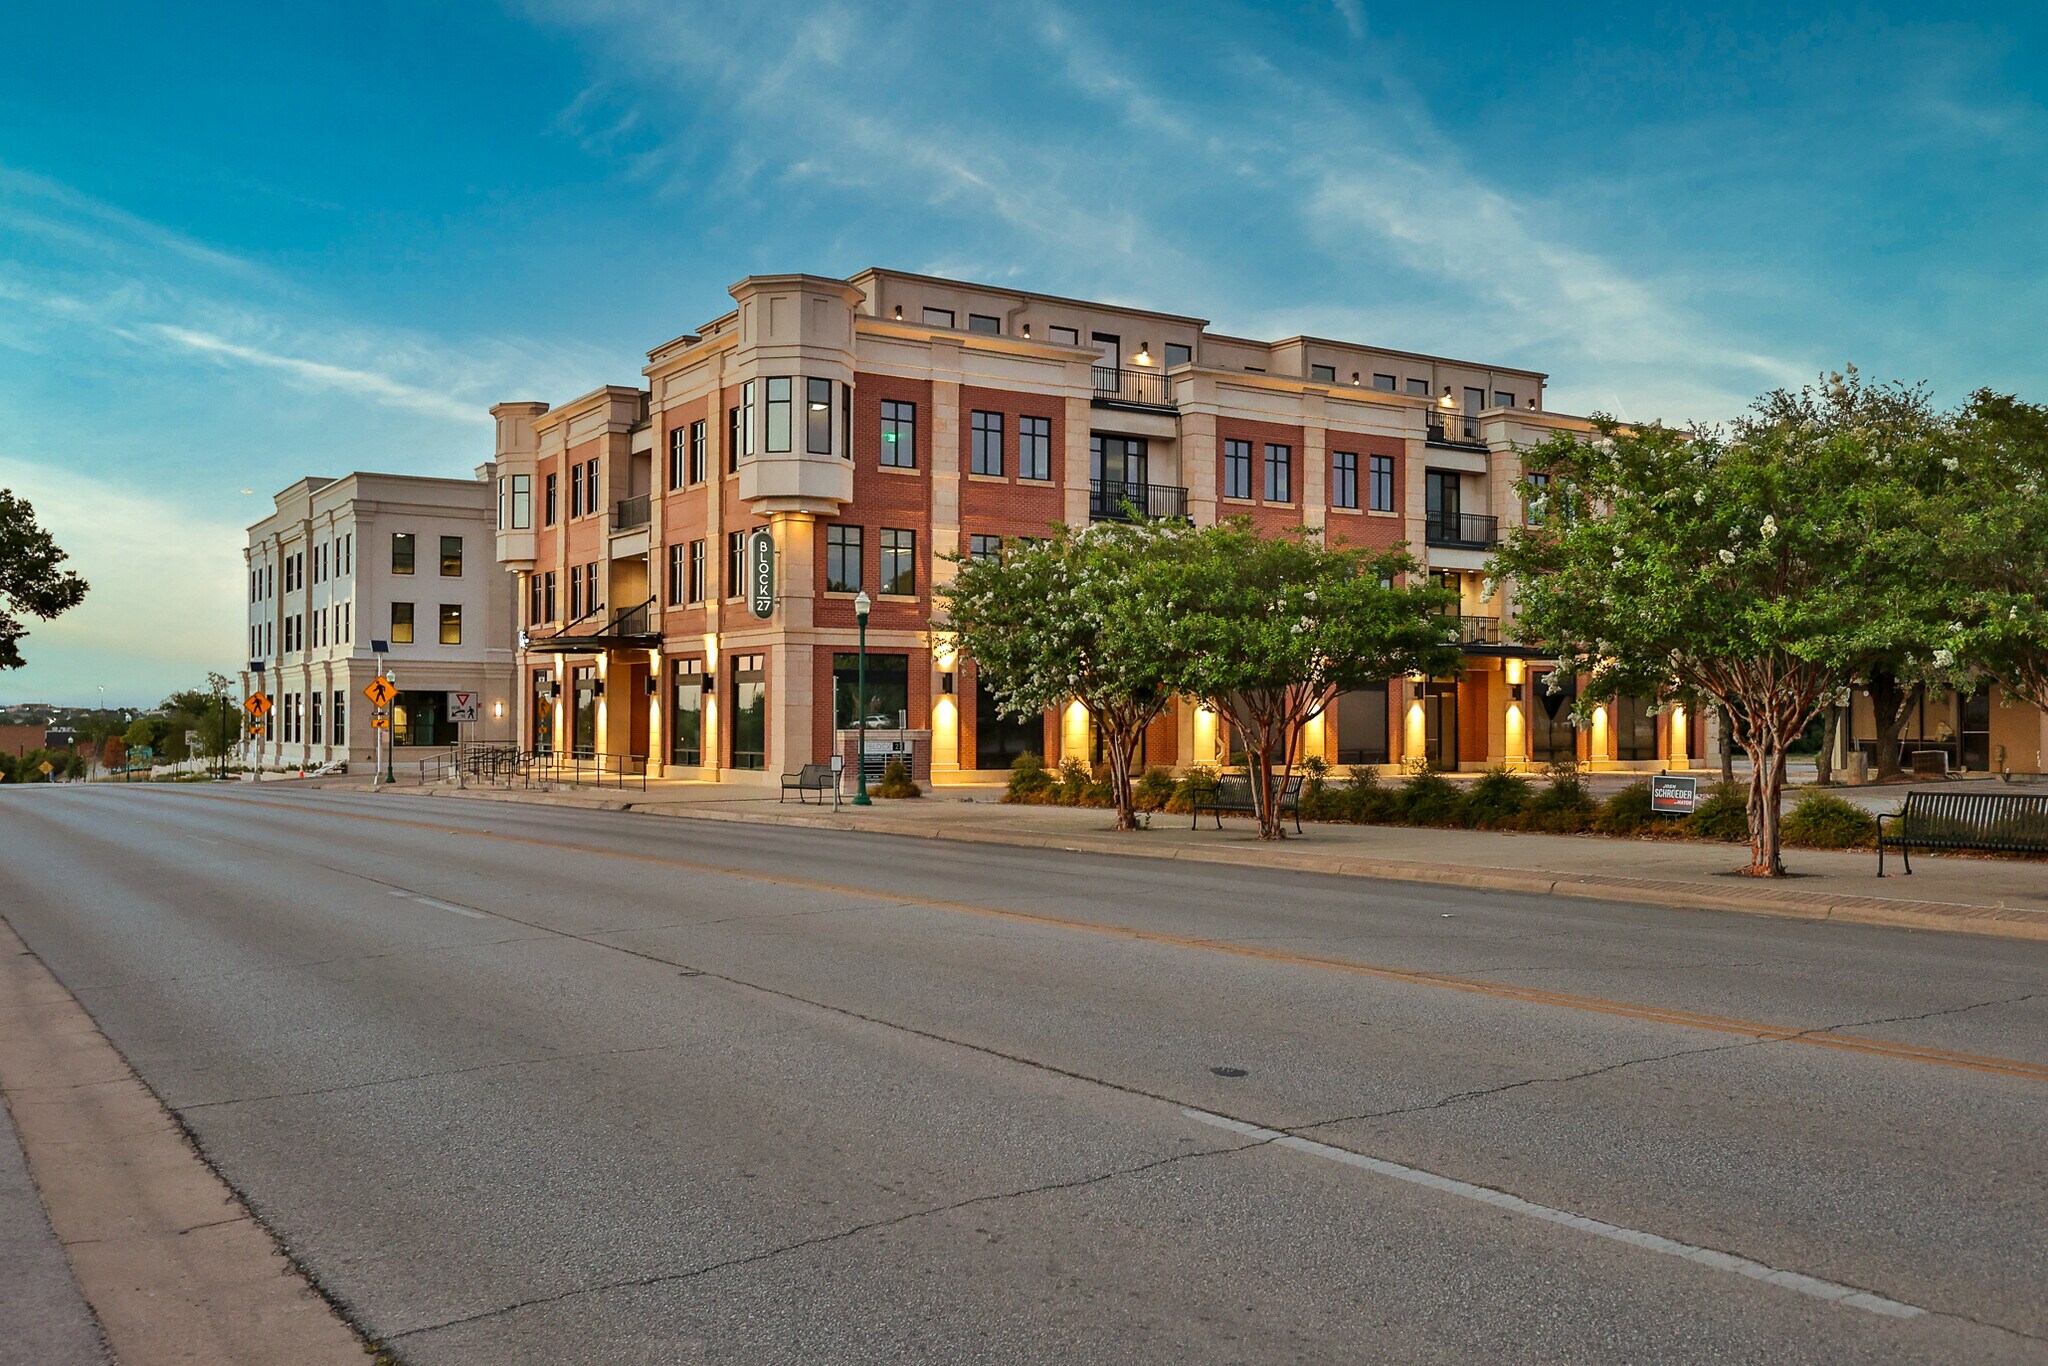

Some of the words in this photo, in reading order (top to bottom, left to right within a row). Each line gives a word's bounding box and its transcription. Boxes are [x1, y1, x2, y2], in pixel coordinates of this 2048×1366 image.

[758, 541, 770, 596] BLOCK
[756, 600, 771, 611] 27
[1654, 788, 1693, 800] SCHROEDER
